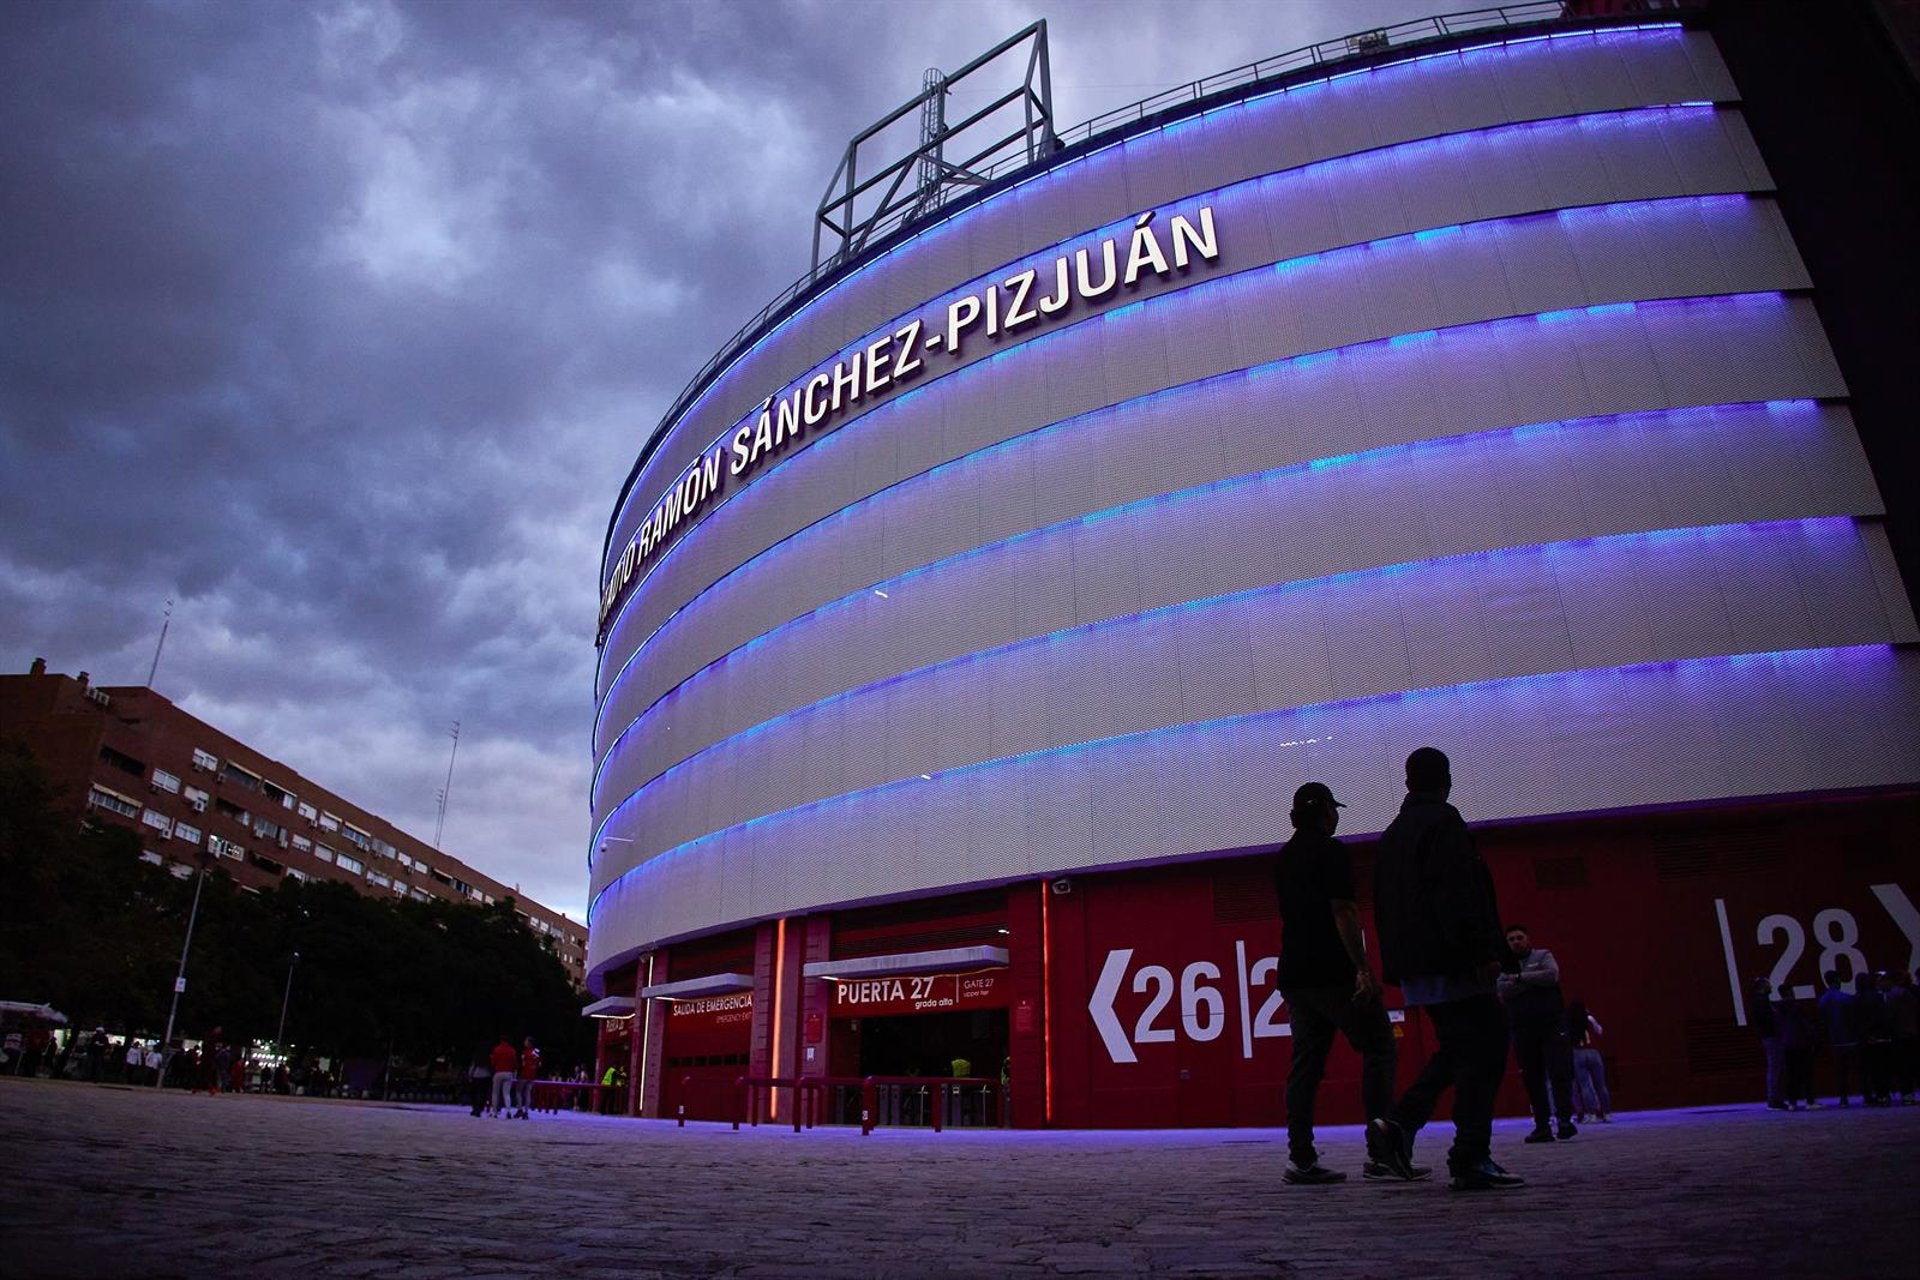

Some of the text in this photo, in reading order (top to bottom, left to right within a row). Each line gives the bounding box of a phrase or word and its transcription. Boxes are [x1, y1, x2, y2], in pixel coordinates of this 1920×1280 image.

[637, 447, 722, 566] RAMÓN
[730, 206, 1219, 476] SÁNCHEZ-PIZJUÁN
[1756, 907, 1869, 1002] 28
[672, 995, 753, 1017] SALIDA DE EMERGENCIA
[837, 976, 935, 1005] PUERTA 27
[962, 977, 995, 990] GATE 27
[1132, 957, 1293, 1043] 26 2
